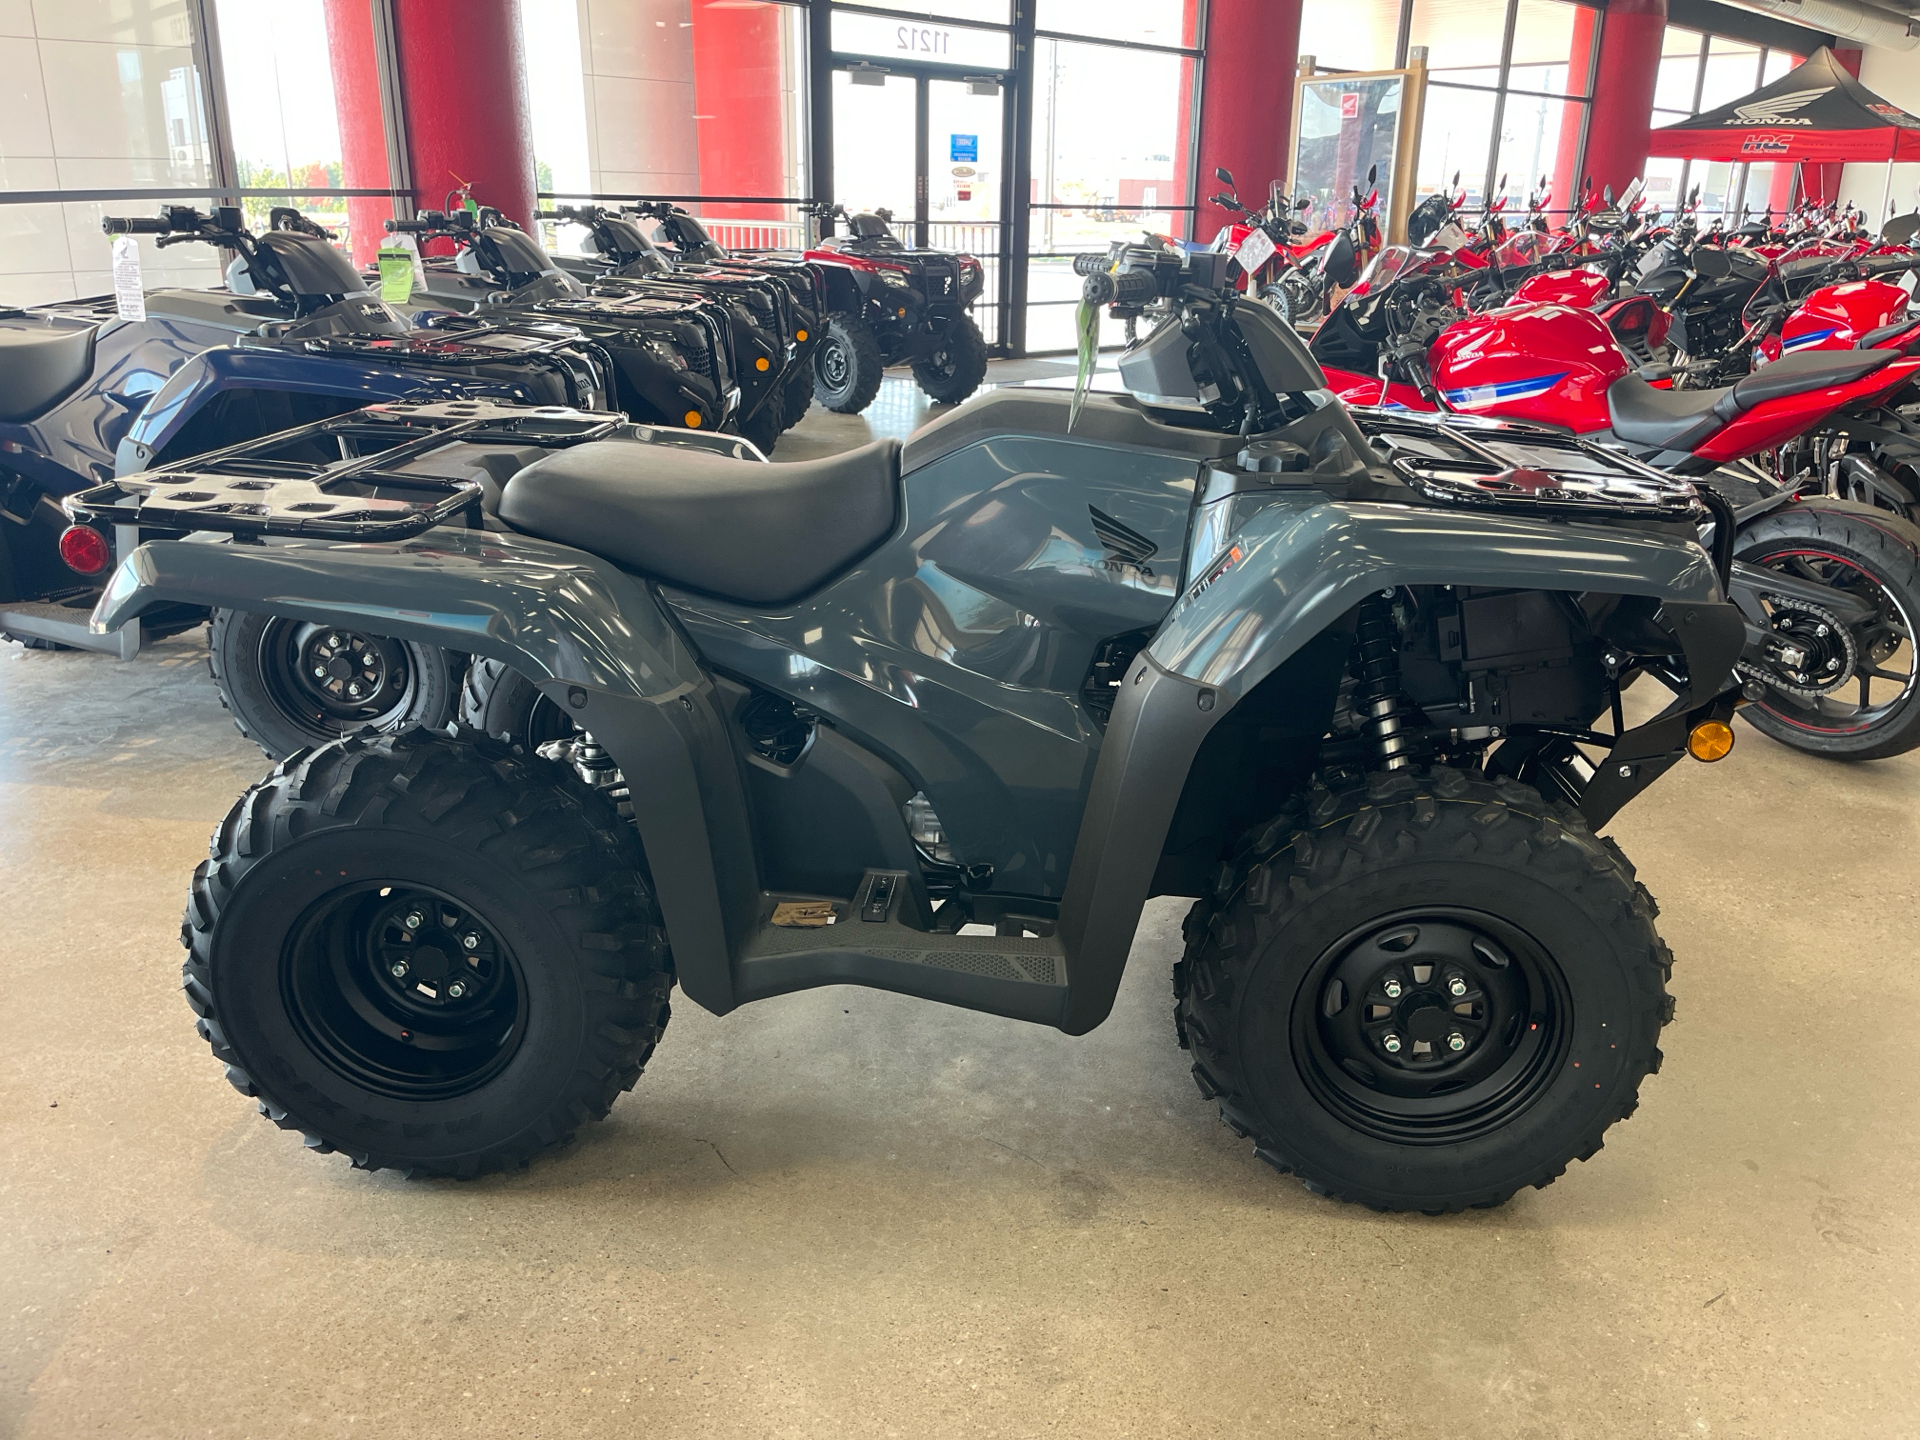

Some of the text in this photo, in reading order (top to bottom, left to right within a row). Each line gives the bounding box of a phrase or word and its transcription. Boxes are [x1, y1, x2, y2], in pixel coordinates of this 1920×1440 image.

[1723, 116, 1813, 126] HONDA
[1742, 134, 1795, 150] HRC
[1452, 351, 1485, 363] HONDA
[577, 378, 592, 391] NDA
[1078, 556, 1156, 577] HONDA
[266, 1054, 483, 1140] MAXXIS
